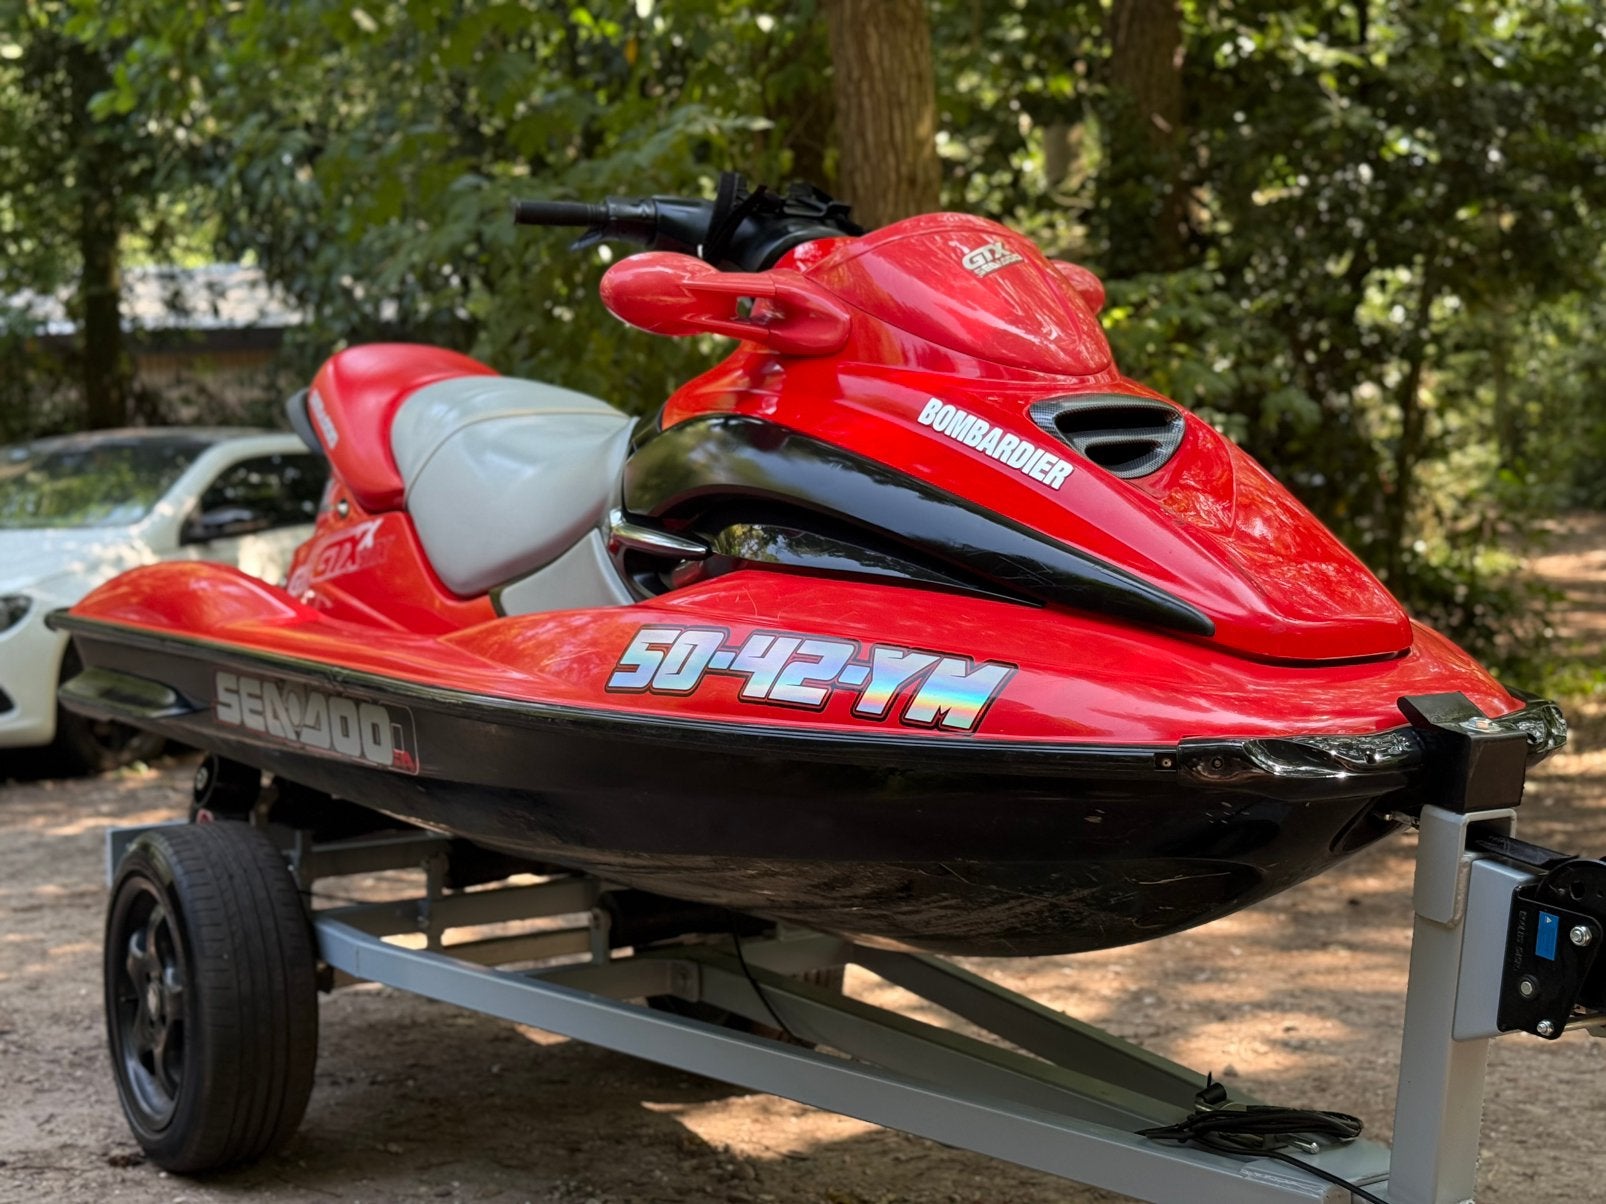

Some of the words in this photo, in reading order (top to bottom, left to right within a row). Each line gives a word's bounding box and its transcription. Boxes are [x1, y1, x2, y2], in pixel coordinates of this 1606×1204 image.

[962, 241, 1011, 271] GTX
[917, 398, 1074, 490] BOMBARDIER
[606, 627, 1015, 733] 50-42-YM
